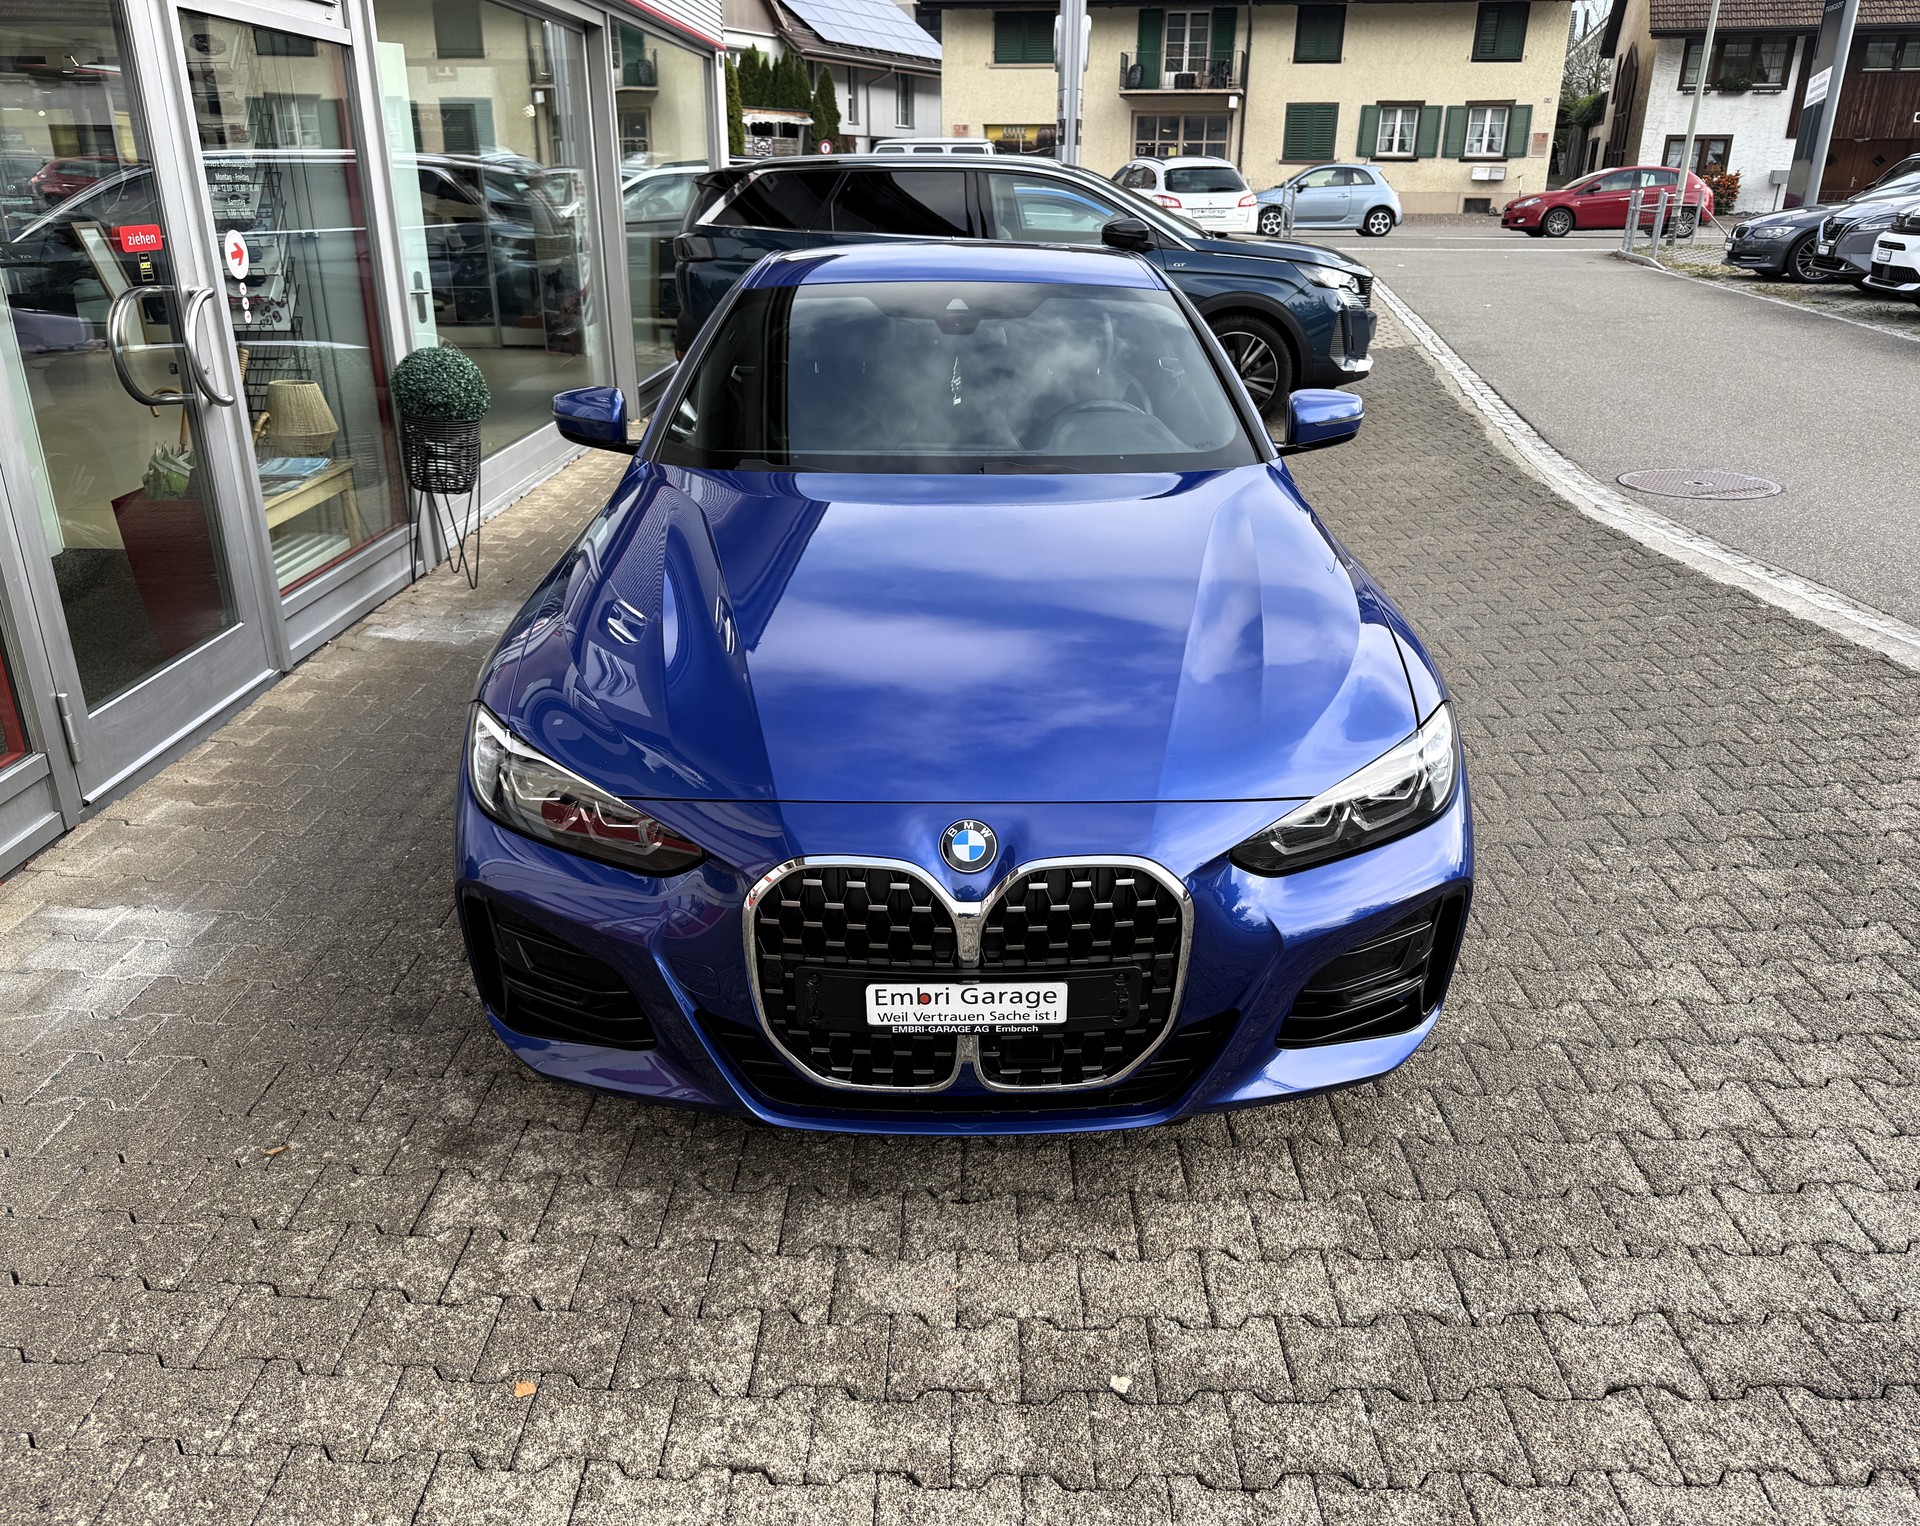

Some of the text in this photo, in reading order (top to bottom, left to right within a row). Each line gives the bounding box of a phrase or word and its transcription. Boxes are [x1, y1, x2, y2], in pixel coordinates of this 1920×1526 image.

[214, 172, 232, 182] Montag
[127, 231, 157, 246] ziehen
[874, 987, 1057, 1009] Embri Garage
[877, 1011, 908, 1022] Weil
[913, 1011, 985, 1022] Vertrauen
[989, 1010, 1031, 1021] Sache
[892, 1024, 1039, 1033] EMBRI-GARAGE AG Embrach
